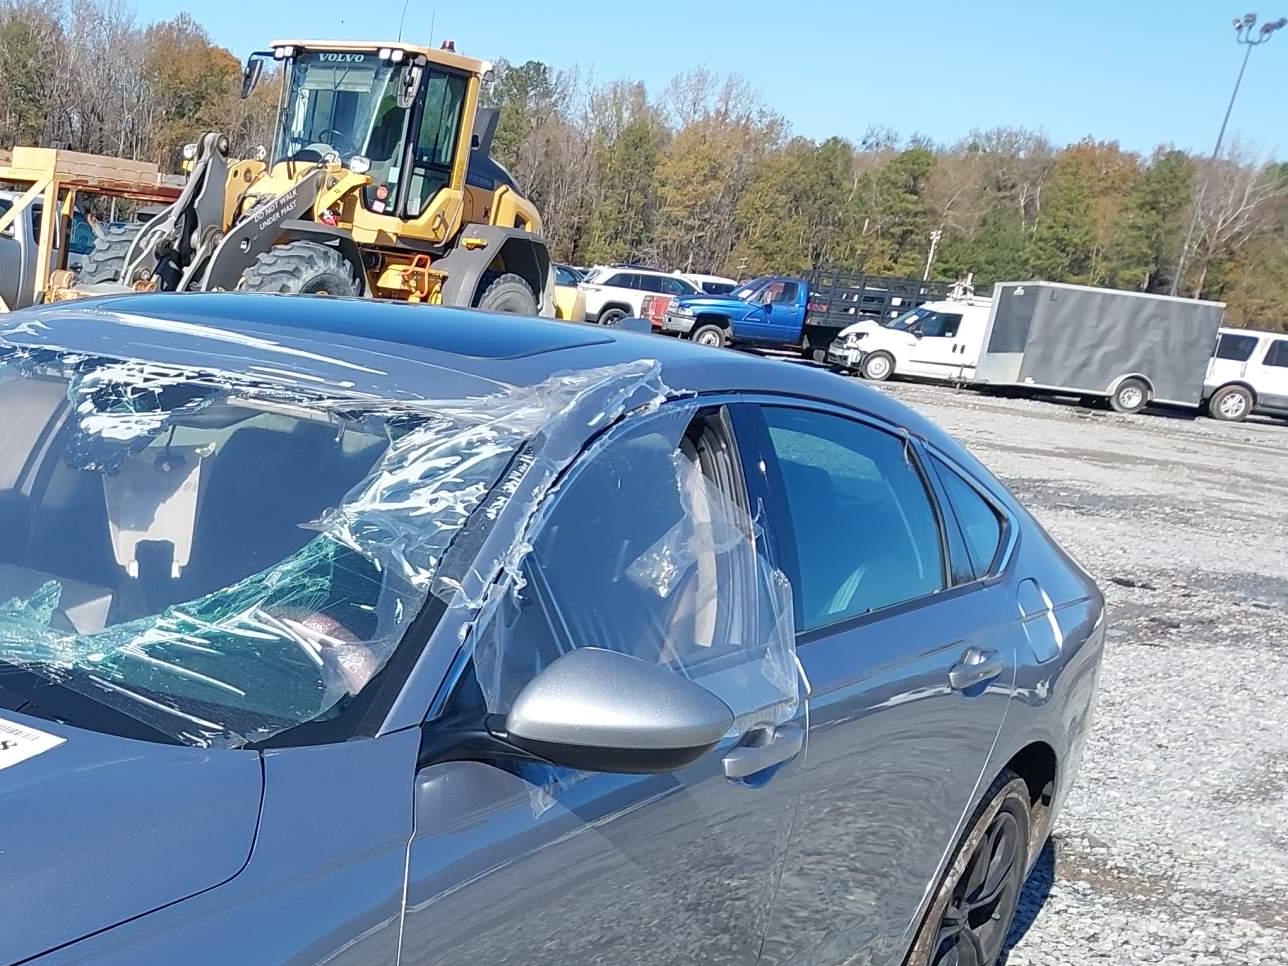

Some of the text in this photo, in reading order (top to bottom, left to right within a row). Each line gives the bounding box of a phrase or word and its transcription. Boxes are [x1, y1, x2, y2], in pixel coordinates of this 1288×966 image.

[319, 53, 364, 63] VOLVO
[254, 188, 298, 223] DO NOT WALK
[259, 199, 297, 231] UNDER MAST
